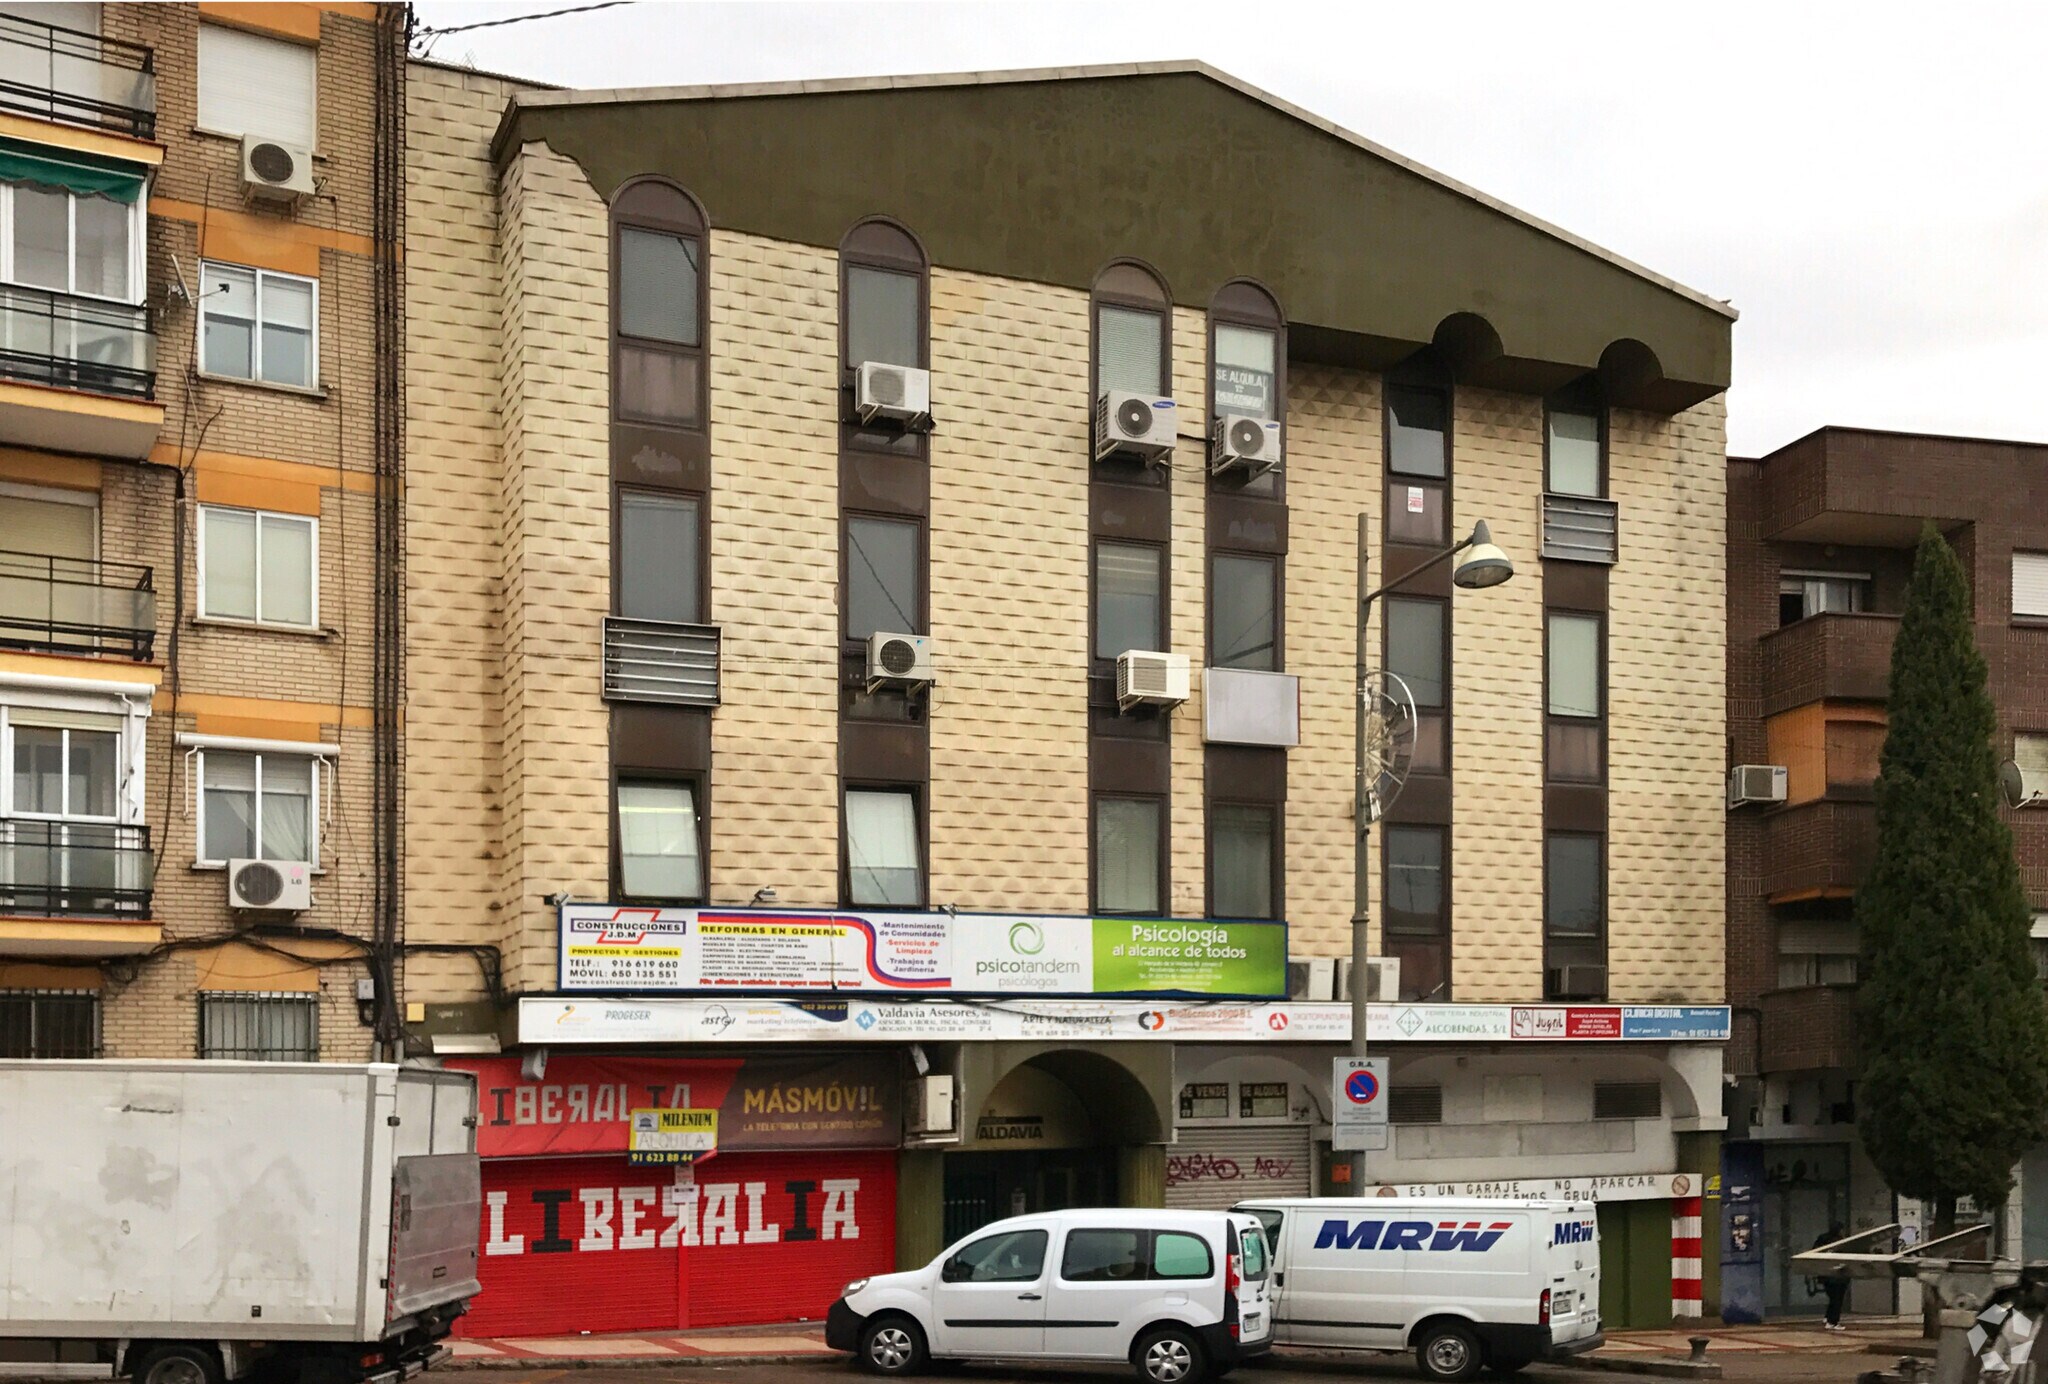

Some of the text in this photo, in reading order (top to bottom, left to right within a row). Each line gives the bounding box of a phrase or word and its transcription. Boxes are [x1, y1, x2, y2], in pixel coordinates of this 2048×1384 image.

[1216, 370, 1262, 387] SE ALQUILA
[577, 921, 680, 931] CONSTRUCCIONES
[608, 931, 640, 939] J.D.M.
[791, 928, 846, 936] GENERAL
[1131, 924, 1228, 947] Psicología
[896, 947, 933, 955] Limpieza
[1112, 944, 1247, 959] al alcance de todos
[612, 960, 631, 968] 916
[636, 960, 655, 968] 619
[976, 958, 1080, 976] psicotandem
[636, 970, 655, 978] 135
[999, 975, 1058, 988] psicólogos
[605, 1010, 651, 1020] PROGESER
[878, 1008, 925, 1018] Valdavia
[929, 1008, 979, 1018] Asesores,
[1055, 1016, 1112, 1024] NATURALEZA
[1182, 1085, 1227, 1097] SE VENDE
[1241, 1085, 1286, 1096] SE ALQUILA
[662, 1113, 712, 1126] MILENIUM
[743, 1123, 754, 1131] LA
[802, 1121, 818, 1130] CON
[821, 1120, 854, 1129] SENTIDO
[640, 1132, 705, 1148] ALQUILA
[631, 1153, 693, 1162] 91 623 88 44
[1410, 1176, 1656, 1197] ES UN GARAJE NO APARCAR
[1564, 1190, 1598, 1201] GRUA
[1313, 1220, 1514, 1252] MRW
[1554, 1220, 1594, 1245] MRW
